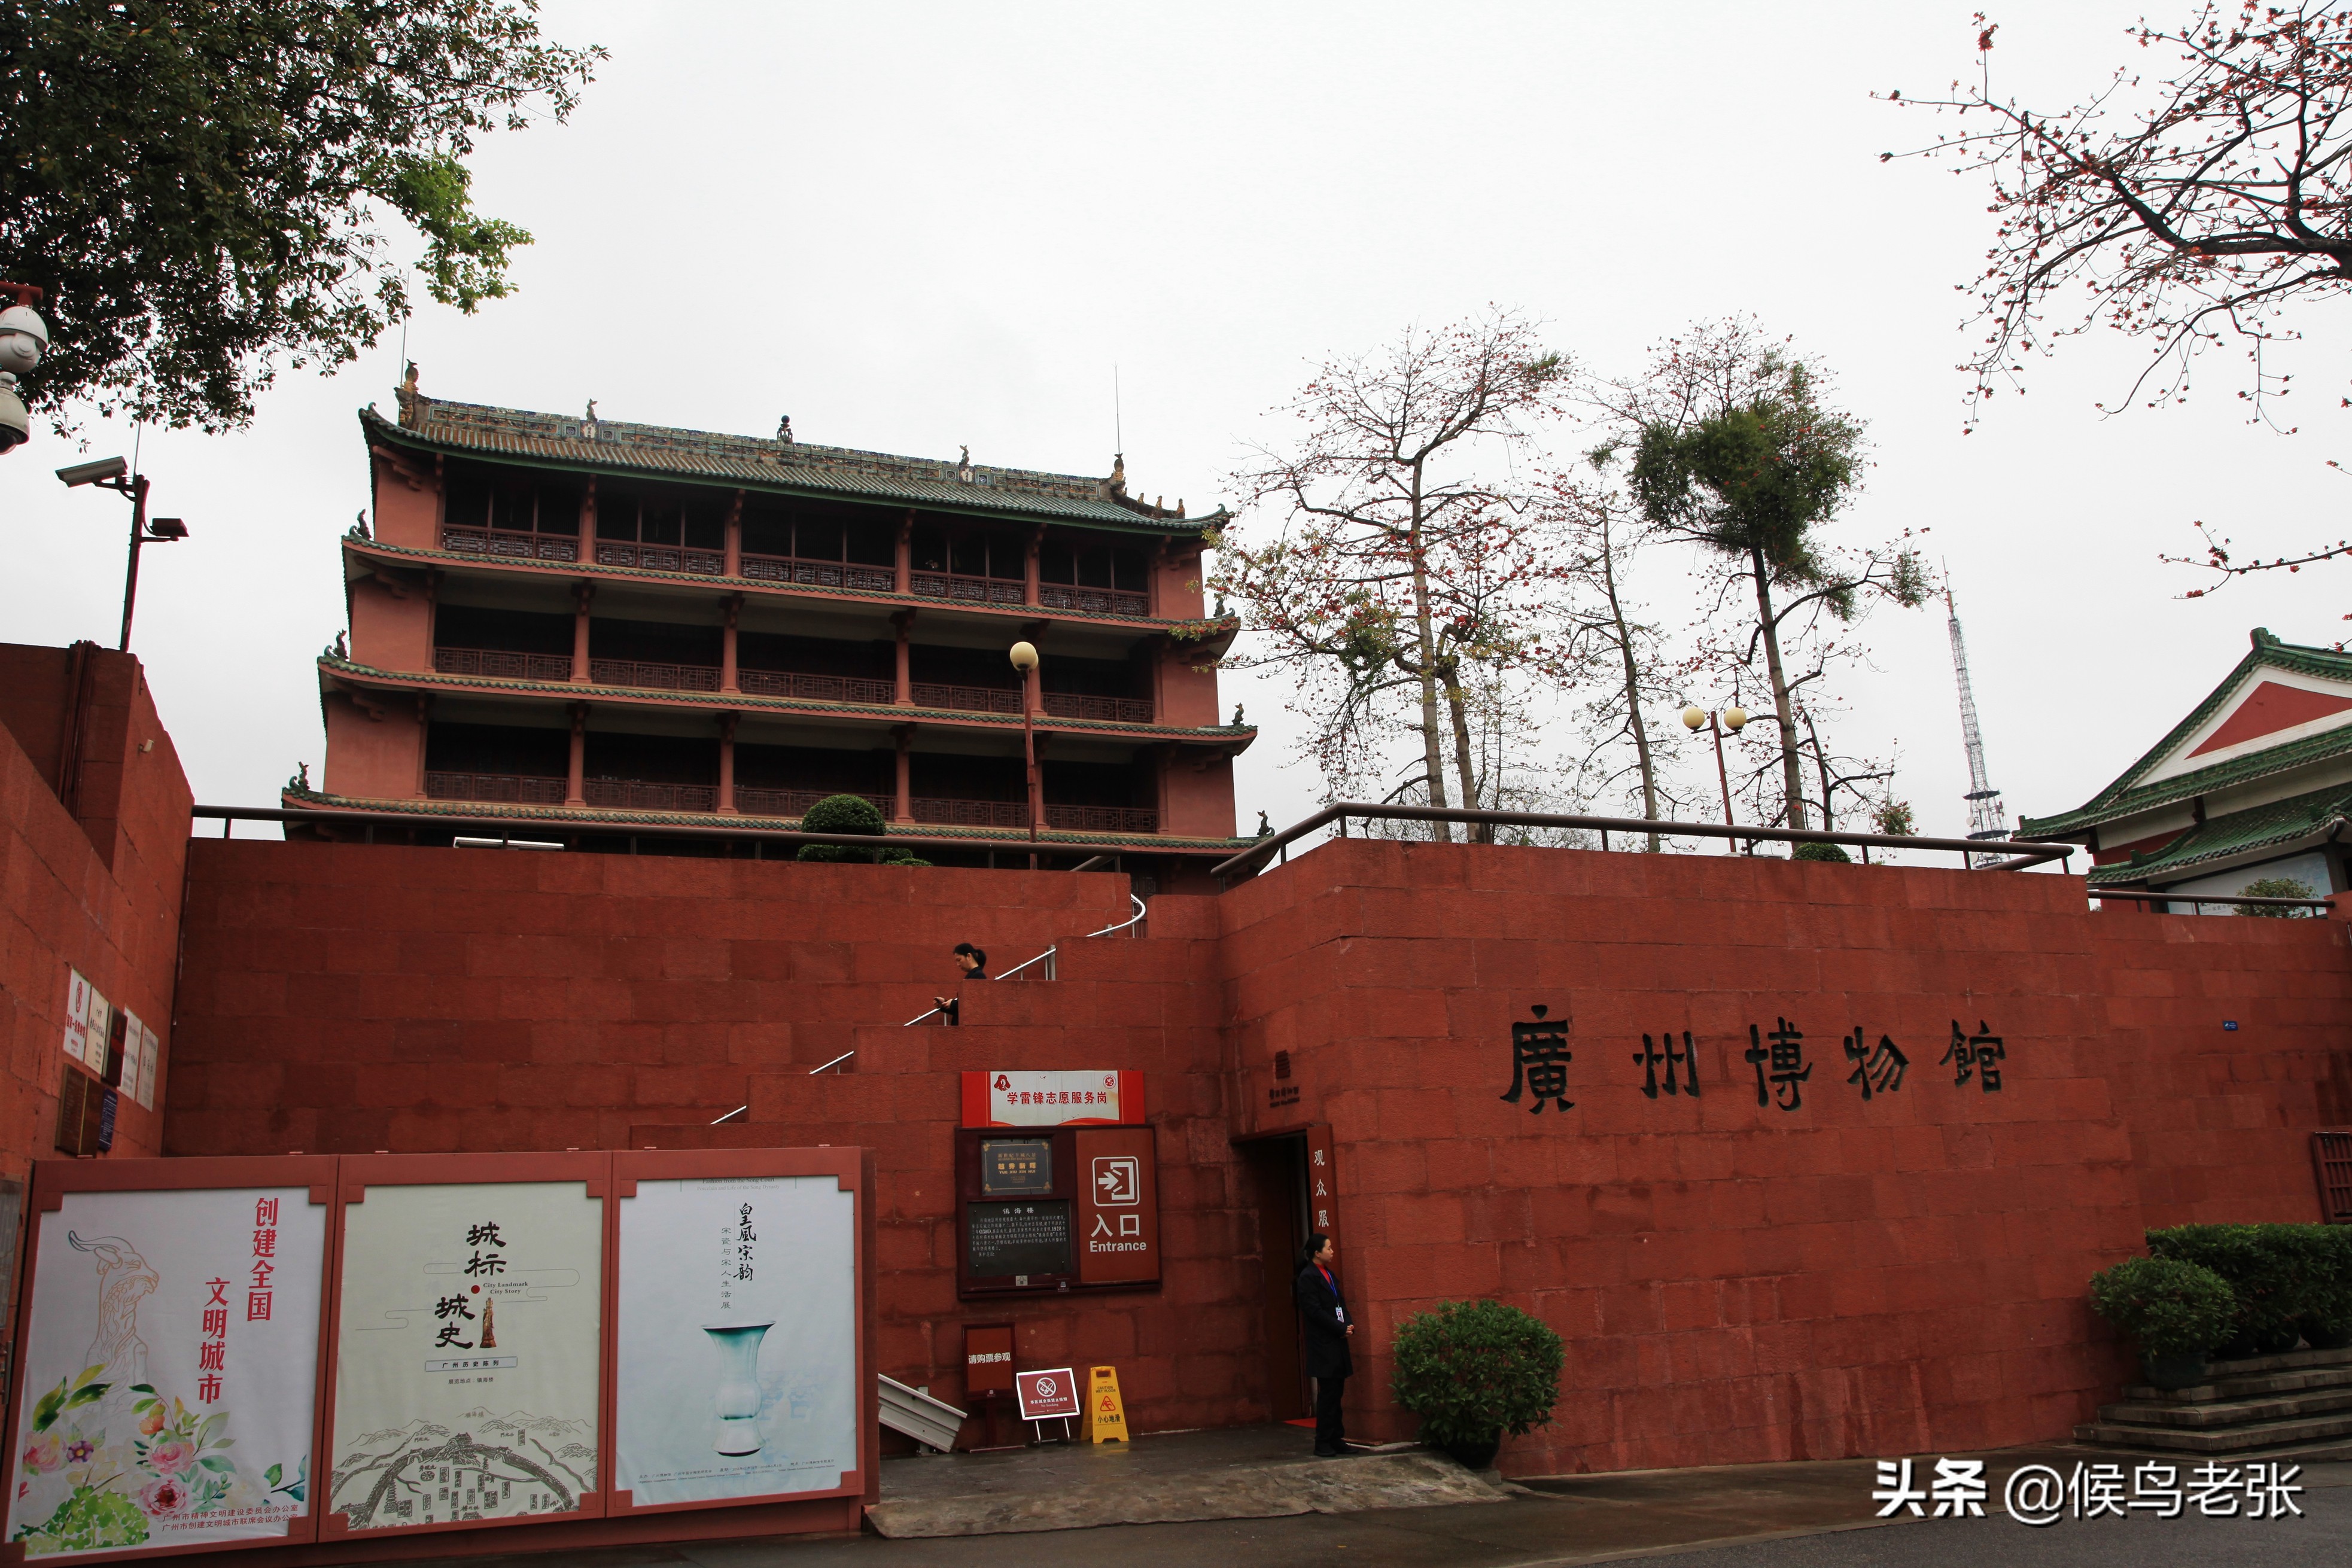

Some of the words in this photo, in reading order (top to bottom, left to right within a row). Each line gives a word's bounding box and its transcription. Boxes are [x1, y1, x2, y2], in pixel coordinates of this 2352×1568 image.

[1499, 1004, 2006, 1115] 廣州博物館
[1007, 1091, 1107, 1106] 学雷锋志愿服务岗
[1090, 1214, 1141, 1238] 入口
[464, 1221, 507, 1278] 城标
[1090, 1240, 1147, 1252] Entrance
[247, 1198, 279, 1322] 创建全国
[720, 1227, 732, 1309] 宋瓷与宋人生活展
[434, 1293, 476, 1349] 城史
[197, 1277, 230, 1405] 文明城市
[442, 1359, 500, 1369] 广州历史陈列
[968, 1352, 1011, 1365] 请购票参观
[1097, 1414, 1121, 1423] 小心地滑
[163, 1504, 299, 1523] 广州市精神文明建设委员会办公室
